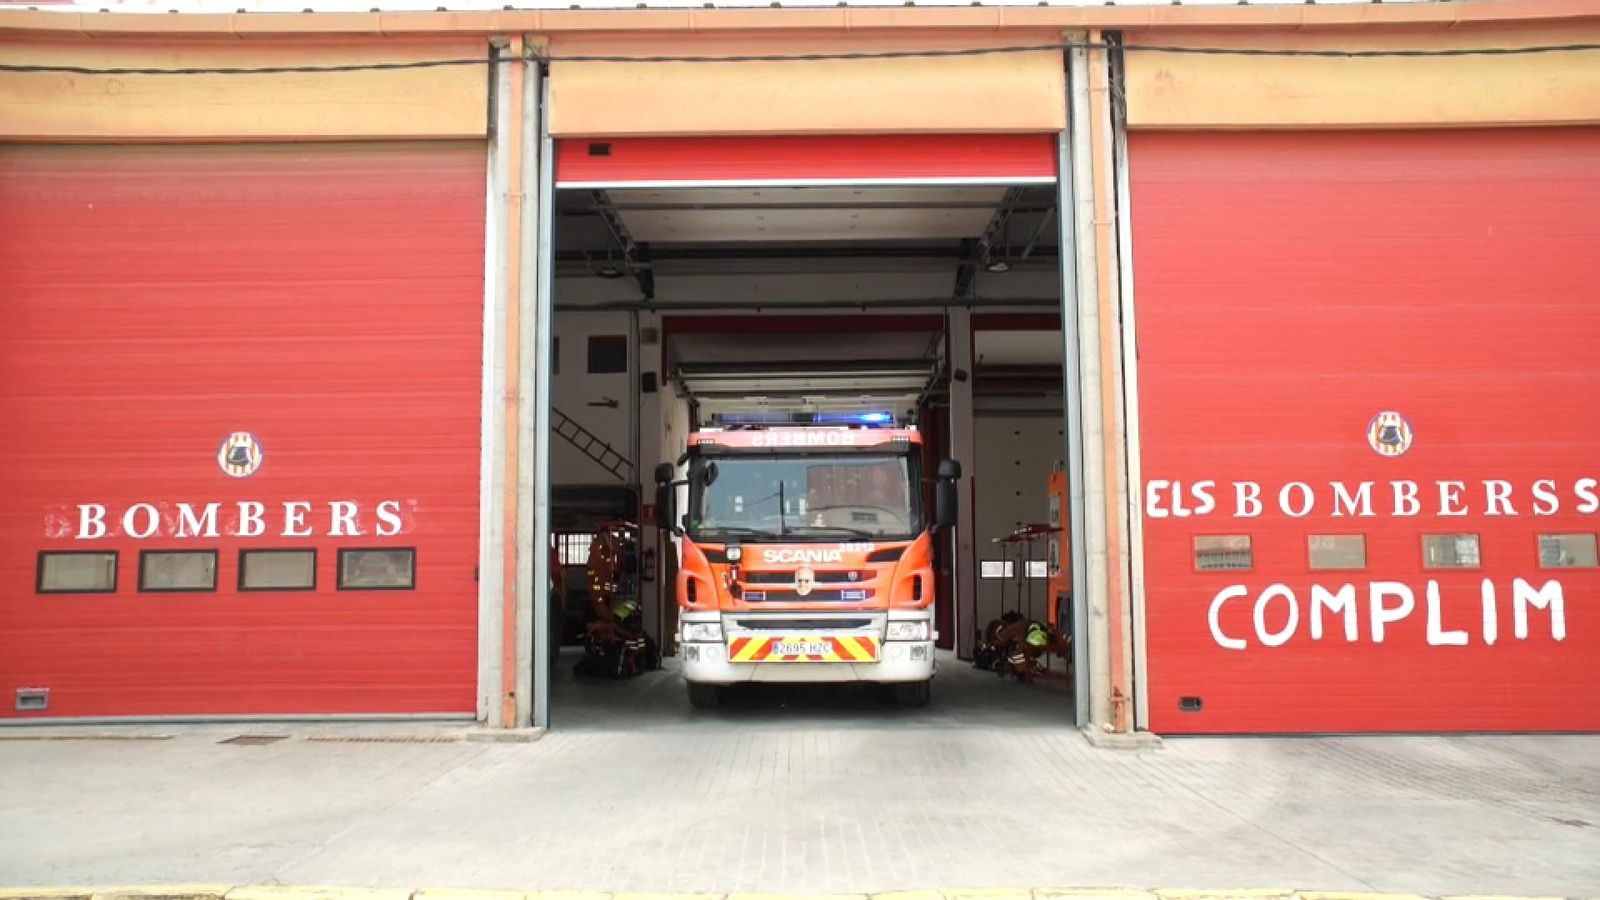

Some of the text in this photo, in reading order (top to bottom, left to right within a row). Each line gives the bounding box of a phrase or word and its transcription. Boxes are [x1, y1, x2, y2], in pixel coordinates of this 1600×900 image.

[1147, 480, 1216, 517] ELS
[1233, 480, 1559, 517] BOMBERS
[75, 501, 402, 539] BOMBERS
[763, 549, 843, 562] SCANIA
[1208, 578, 1566, 650] COMPLIM
[780, 643, 831, 654] 2695 HZC
